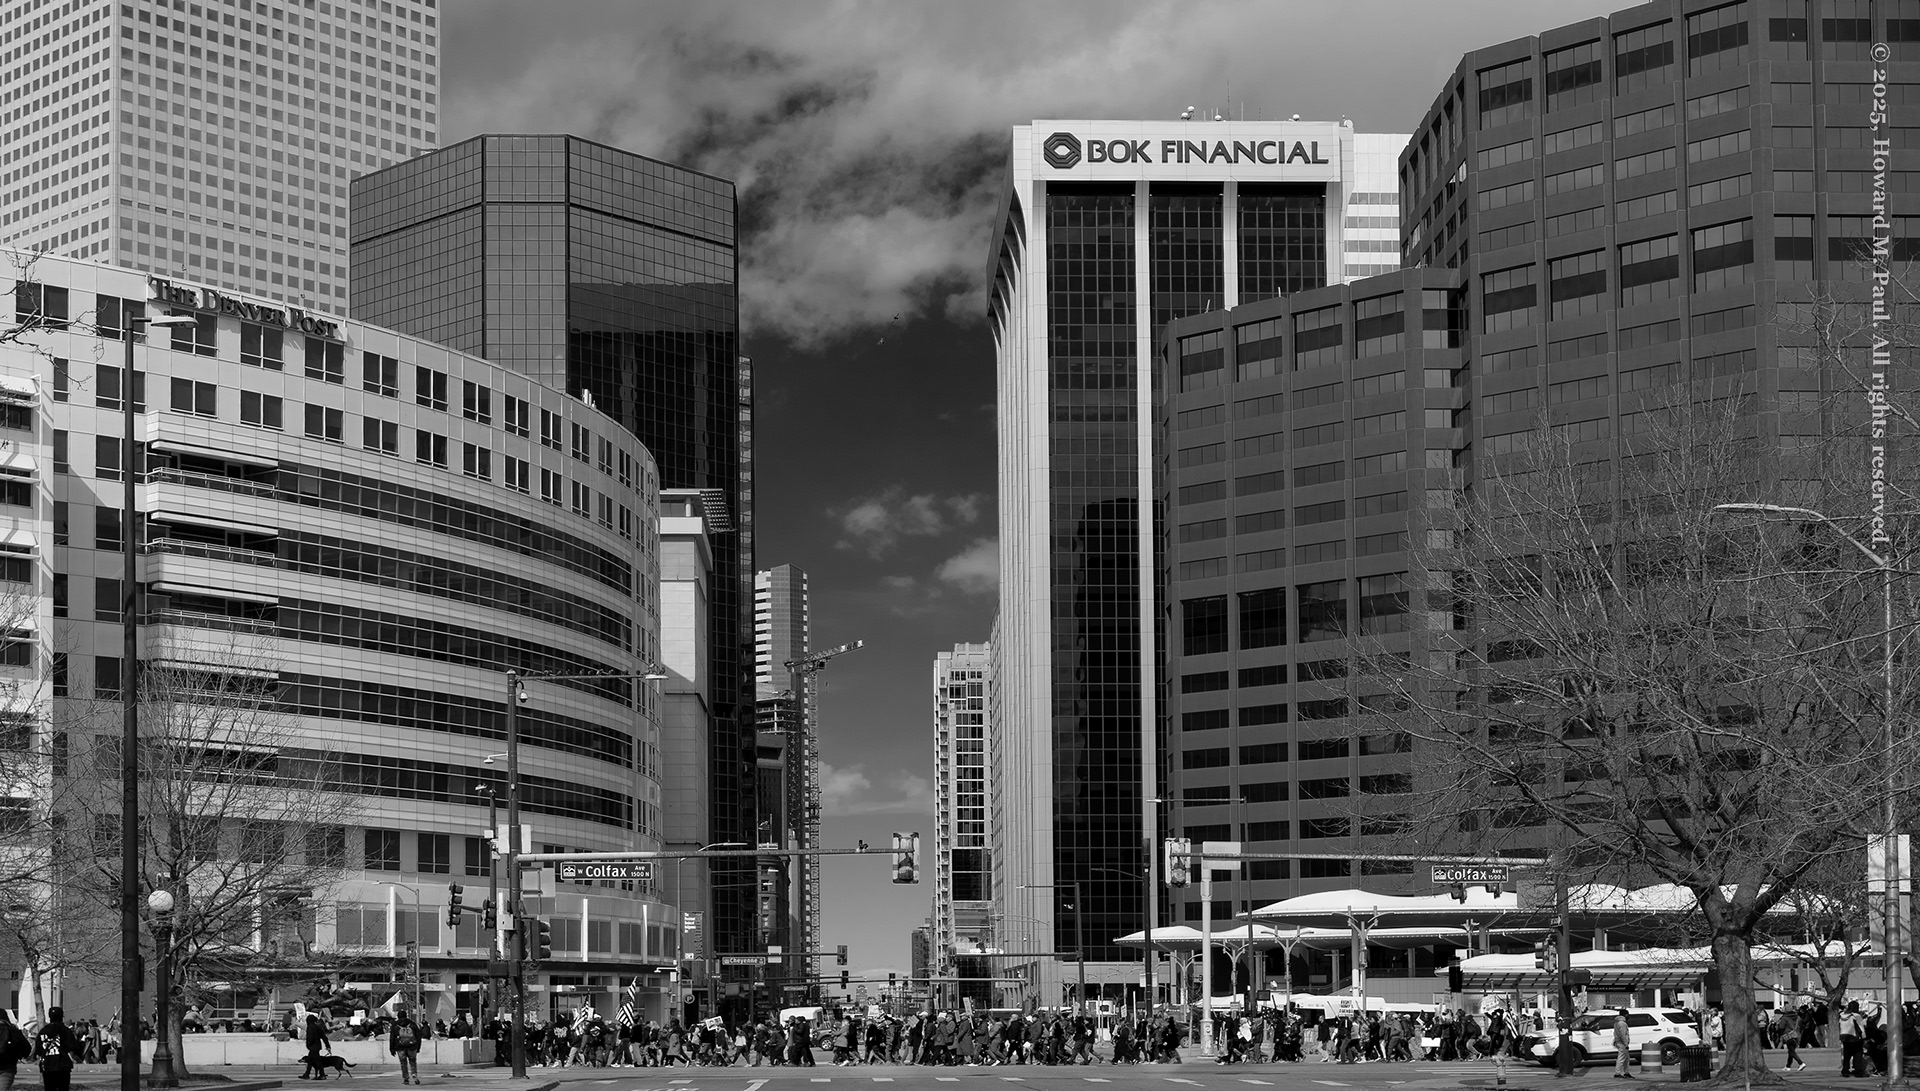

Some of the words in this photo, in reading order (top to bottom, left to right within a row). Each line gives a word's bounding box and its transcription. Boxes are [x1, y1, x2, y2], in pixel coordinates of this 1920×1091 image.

[1087, 140, 1152, 163] BOK
[1161, 140, 1329, 164] FINANCIAL
[149, 278, 199, 307] THE
[200, 286, 289, 328] DENVER
[289, 306, 338, 339] POST
[586, 865, 627, 877] Colfax
[1447, 868, 1487, 880] Colfax
[729, 957, 758, 965] Cheyenne
